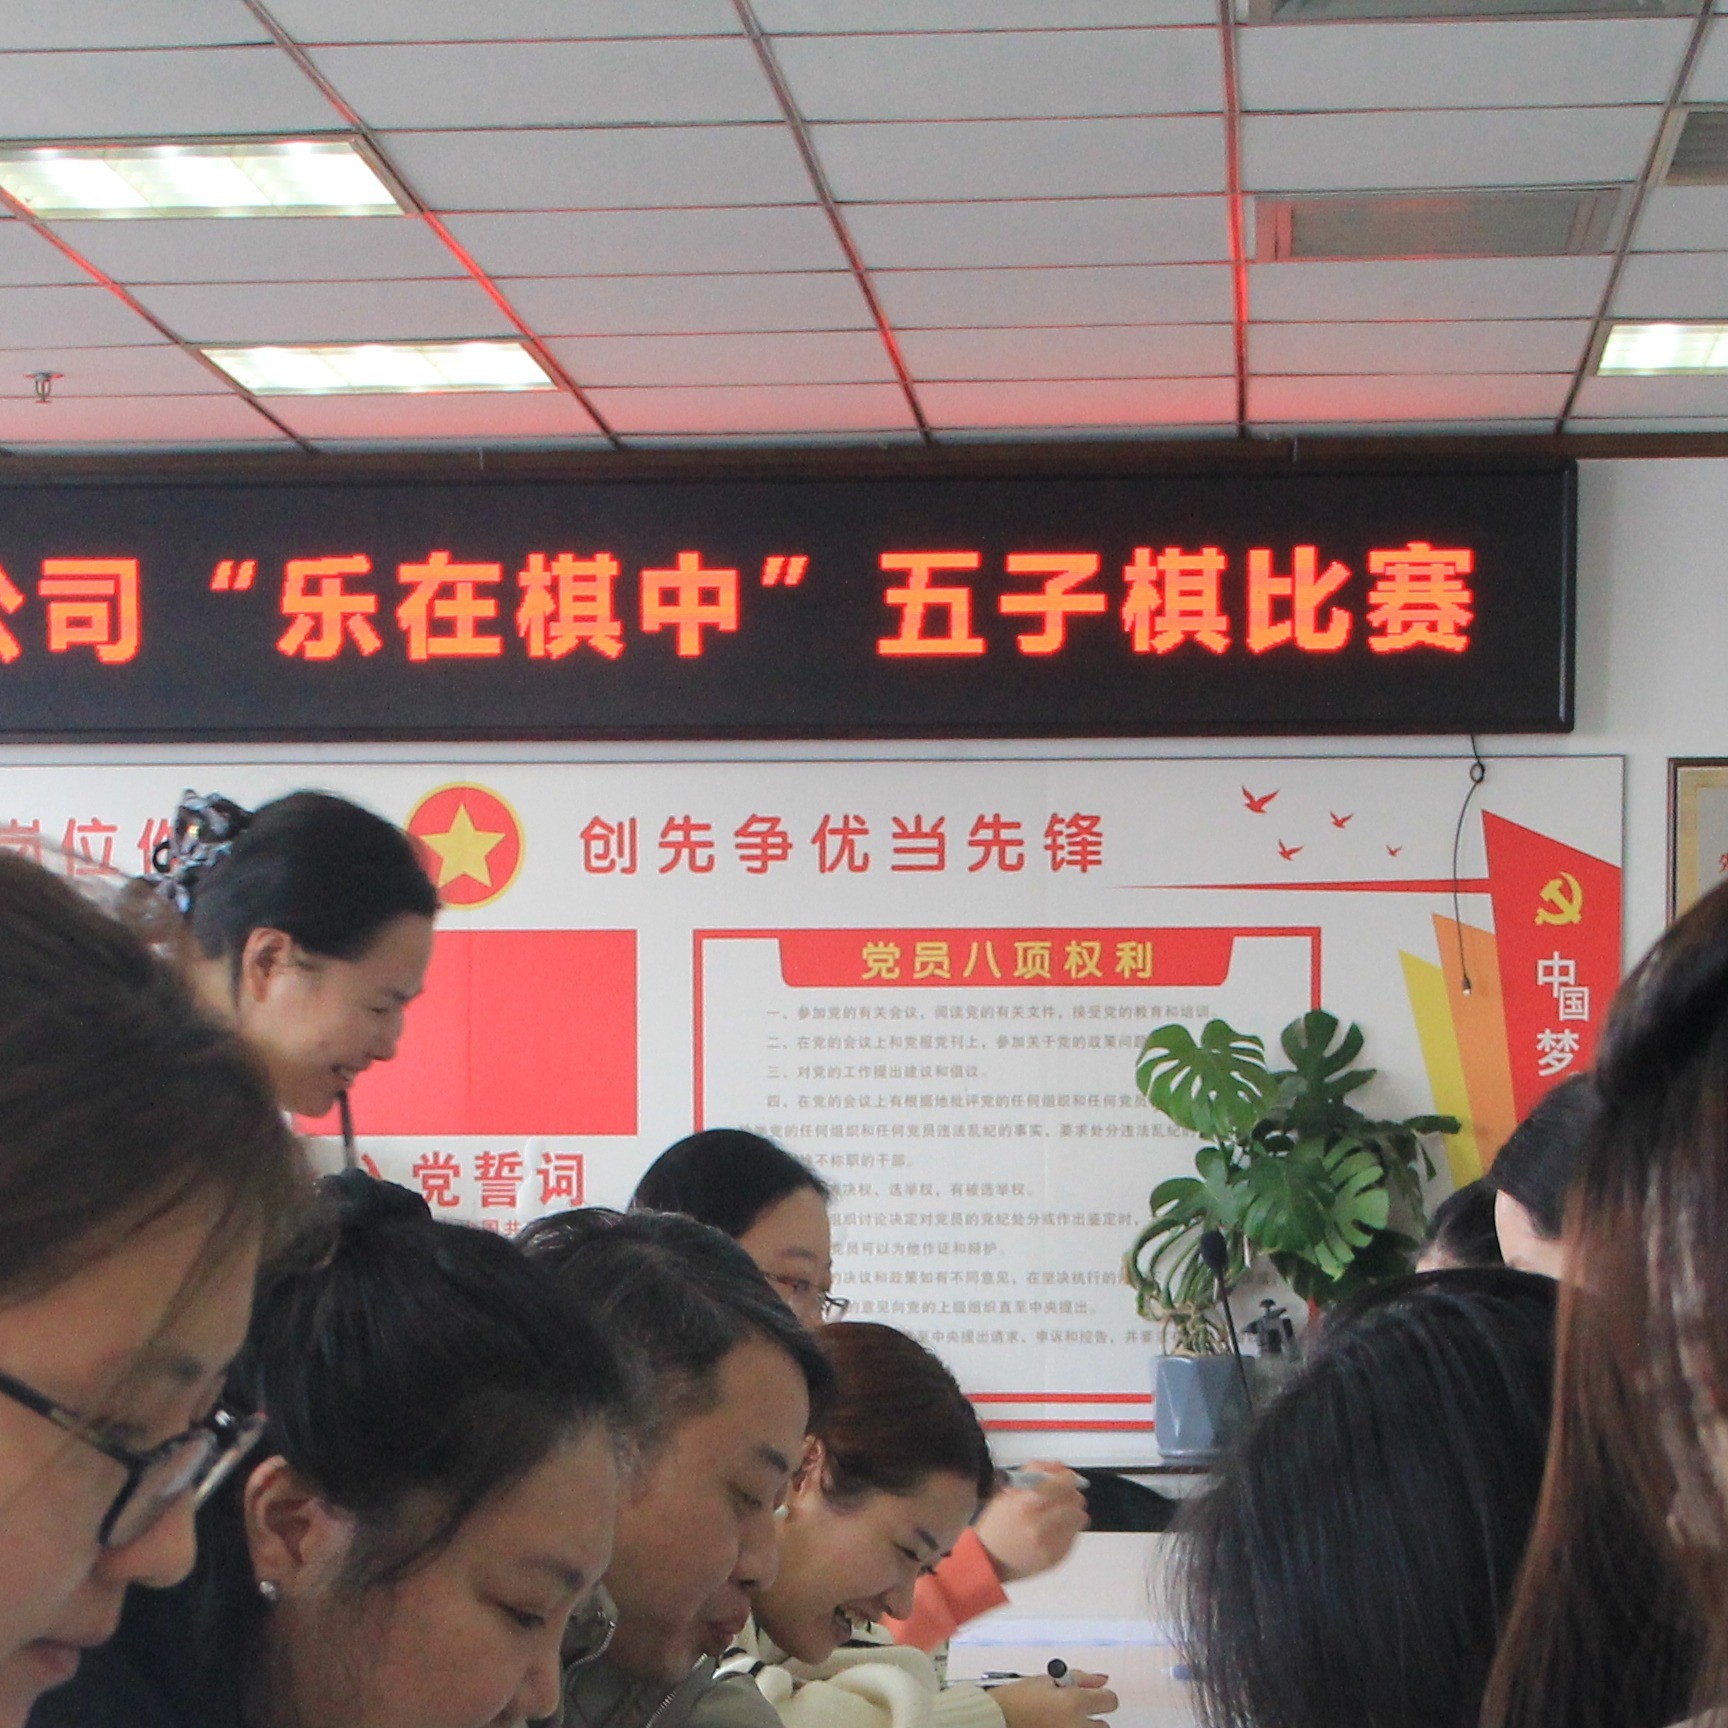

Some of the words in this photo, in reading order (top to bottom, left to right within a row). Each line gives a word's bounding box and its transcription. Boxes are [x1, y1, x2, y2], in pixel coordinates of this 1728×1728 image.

[579, 812, 1105, 876] 创先争优当先锋
[861, 939, 1153, 980] 党员八项权利
[1536, 951, 1590, 1077] 中国梦
